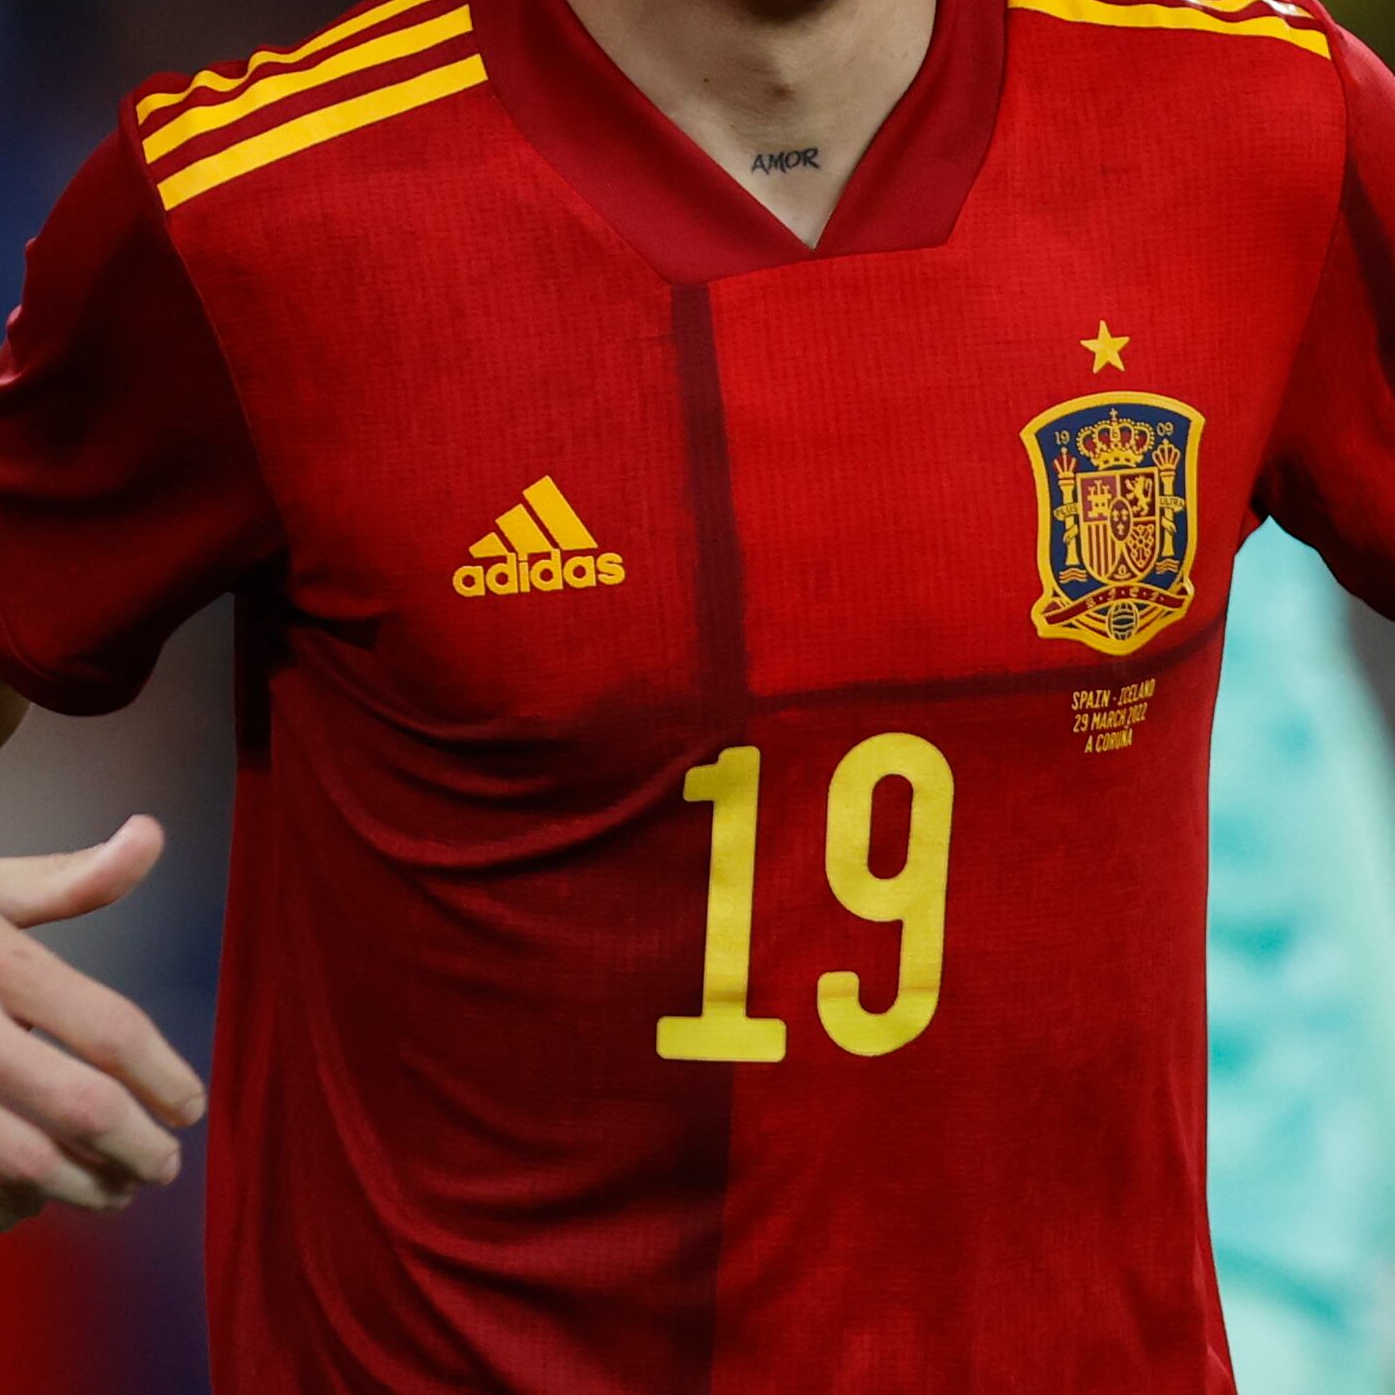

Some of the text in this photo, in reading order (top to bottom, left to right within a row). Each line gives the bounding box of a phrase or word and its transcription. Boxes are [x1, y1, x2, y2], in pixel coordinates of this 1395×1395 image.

[750, 147, 821, 175] AMOR
[1055, 431, 1070, 444] 19
[1157, 422, 1174, 436] 09
[453, 548, 626, 597] adidas
[1071, 690, 1111, 711] SPAIN
[1073, 713, 1089, 733] 29
[1091, 707, 1127, 731] MARCH
[1084, 735, 1093, 753] A
[656, 732, 955, 1063] 19
